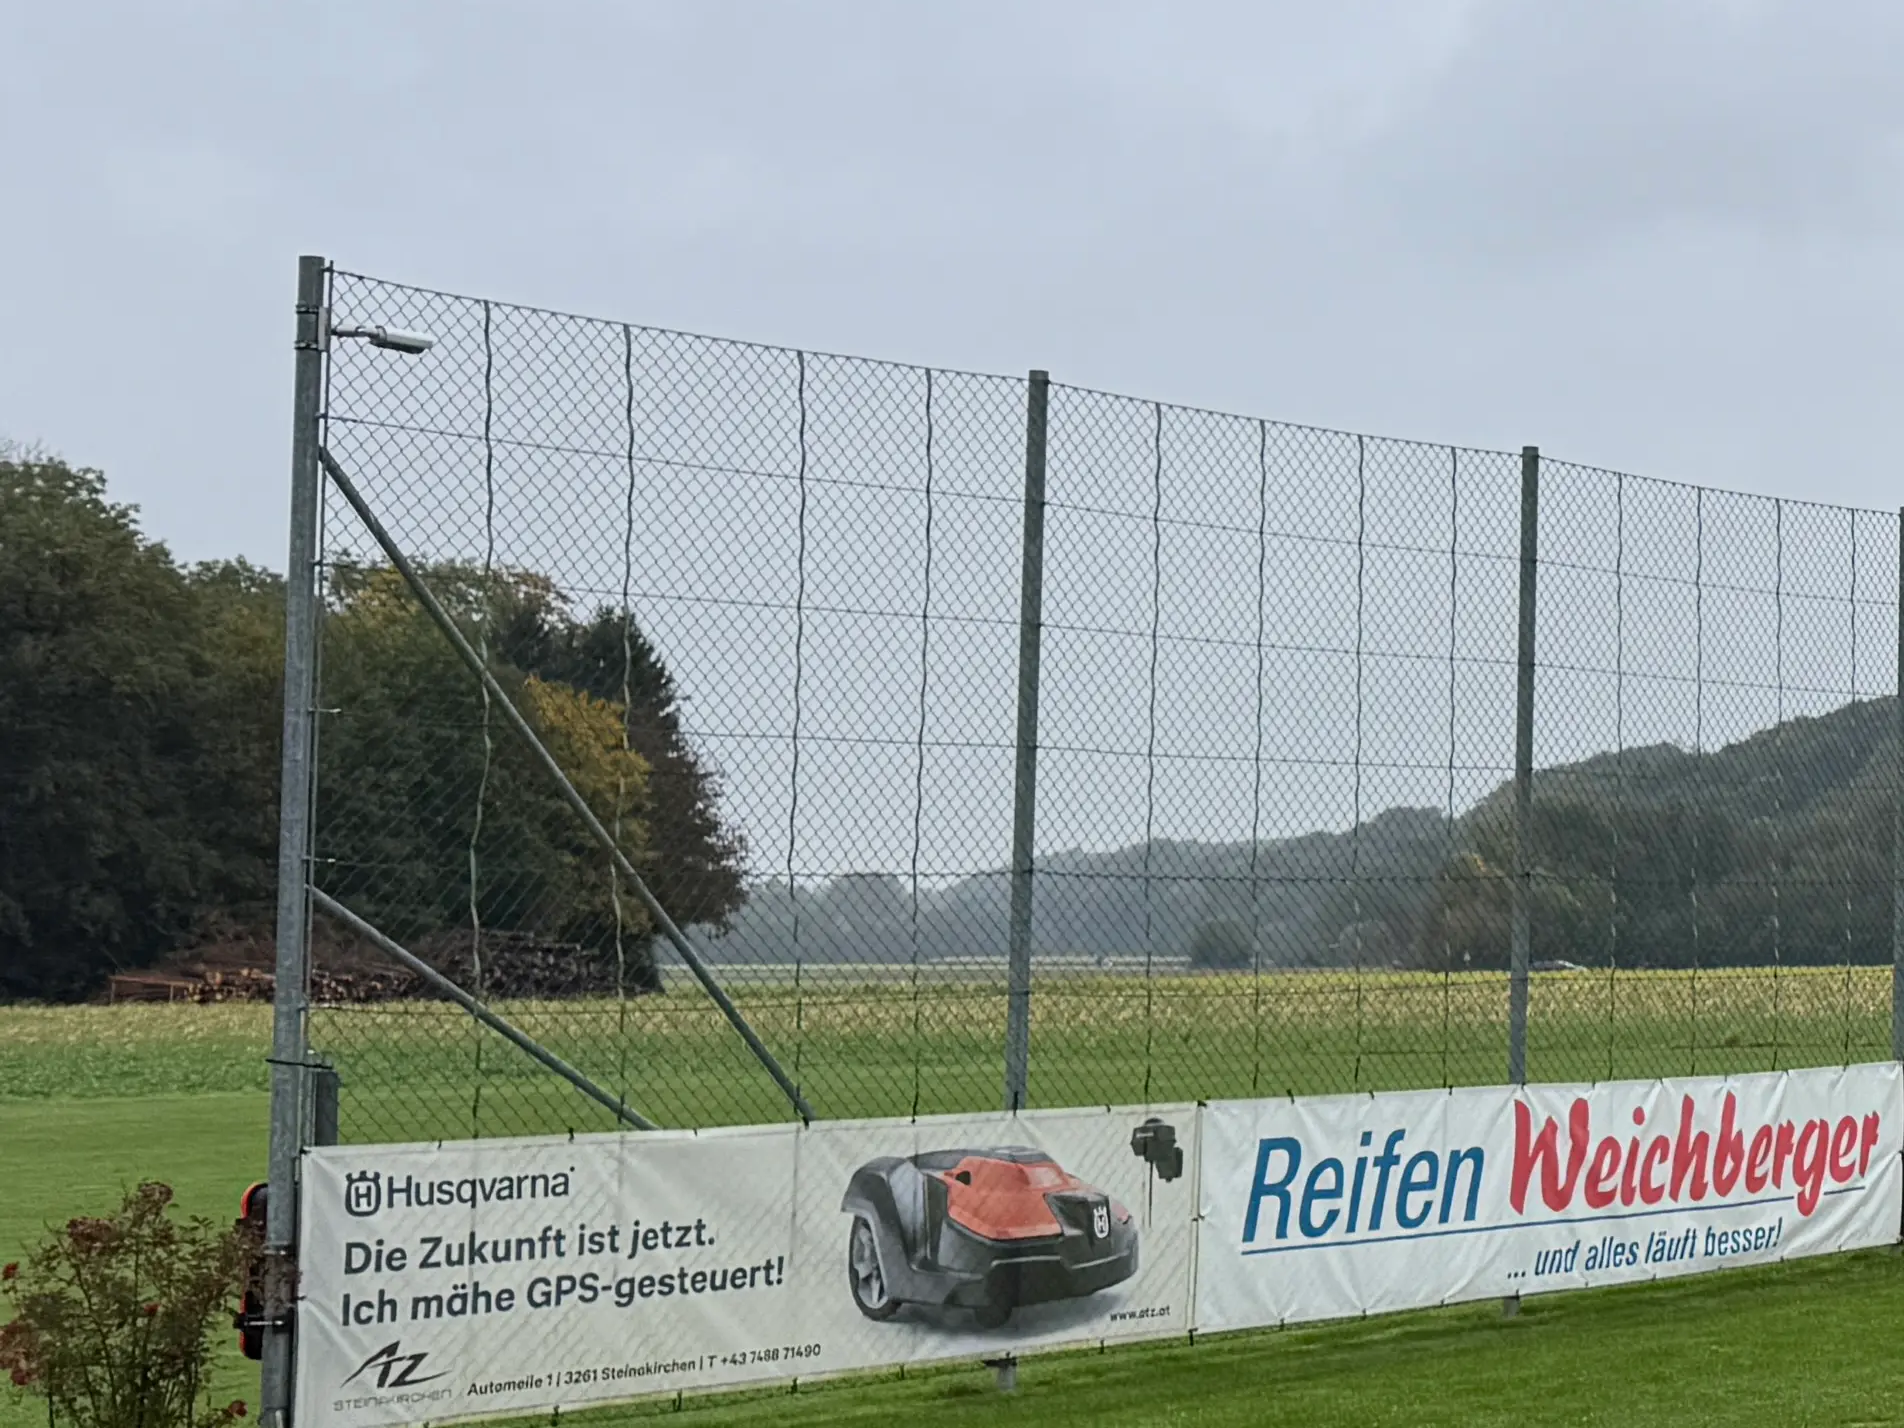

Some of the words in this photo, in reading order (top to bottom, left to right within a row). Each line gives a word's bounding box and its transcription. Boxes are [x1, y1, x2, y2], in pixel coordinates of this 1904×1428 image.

[387, 1172, 570, 1209] Husqvarna
[1242, 1128, 1485, 1243] Reifen
[1508, 1091, 1880, 1217] Weichberger
[344, 1239, 407, 1275] Die
[419, 1225, 566, 1269] Zukunft
[578, 1223, 620, 1256] ist
[627, 1218, 715, 1259] jetzt.
[1534, 1239, 1580, 1277] und
[1584, 1234, 1639, 1271] alles
[1645, 1227, 1698, 1265] läuft
[1704, 1217, 1783, 1259] besser!
[342, 1289, 397, 1326] Ich
[411, 1281, 516, 1320] mähe
[526, 1255, 785, 1310] GPS-gesteuert!
[564, 1368, 598, 1385] 3261
[601, 1358, 696, 1382] Steinakirchen
